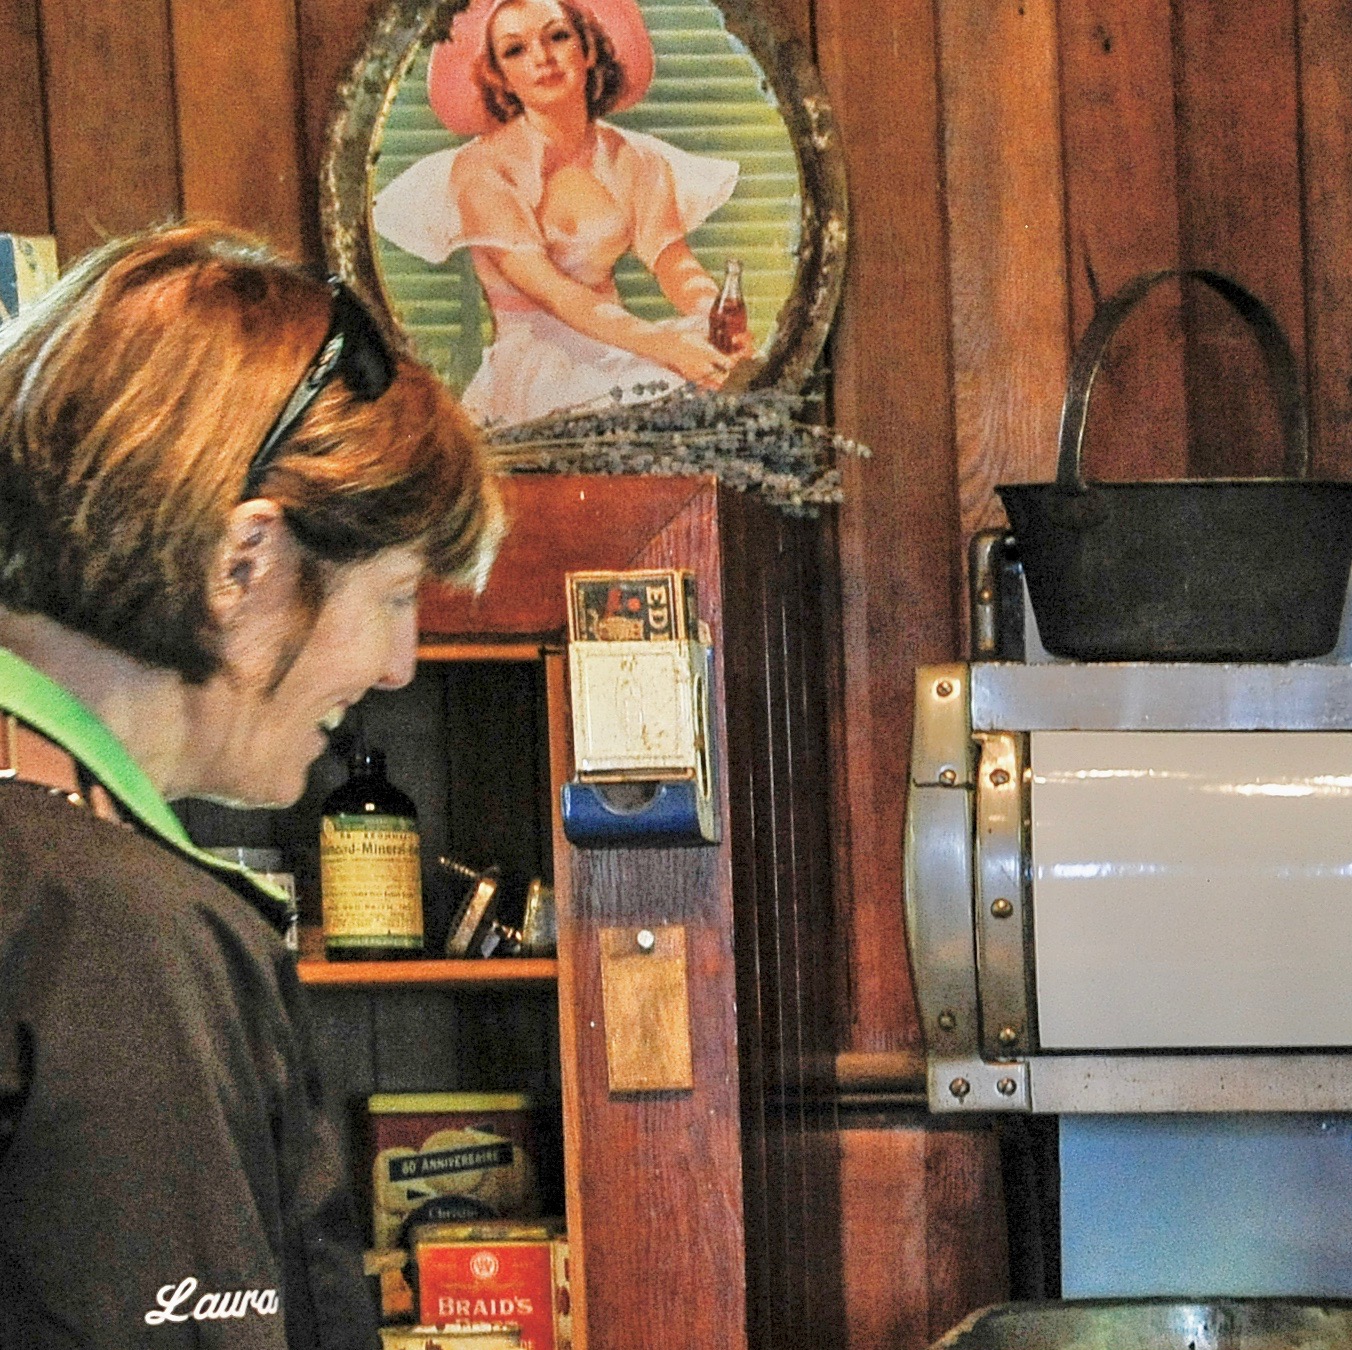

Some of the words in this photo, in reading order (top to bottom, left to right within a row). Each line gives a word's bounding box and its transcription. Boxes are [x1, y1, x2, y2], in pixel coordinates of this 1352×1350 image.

[646, 586, 669, 641] ED
[144, 1276, 279, 1325] Laura
[438, 1296, 533, 1316] BRAID'S
